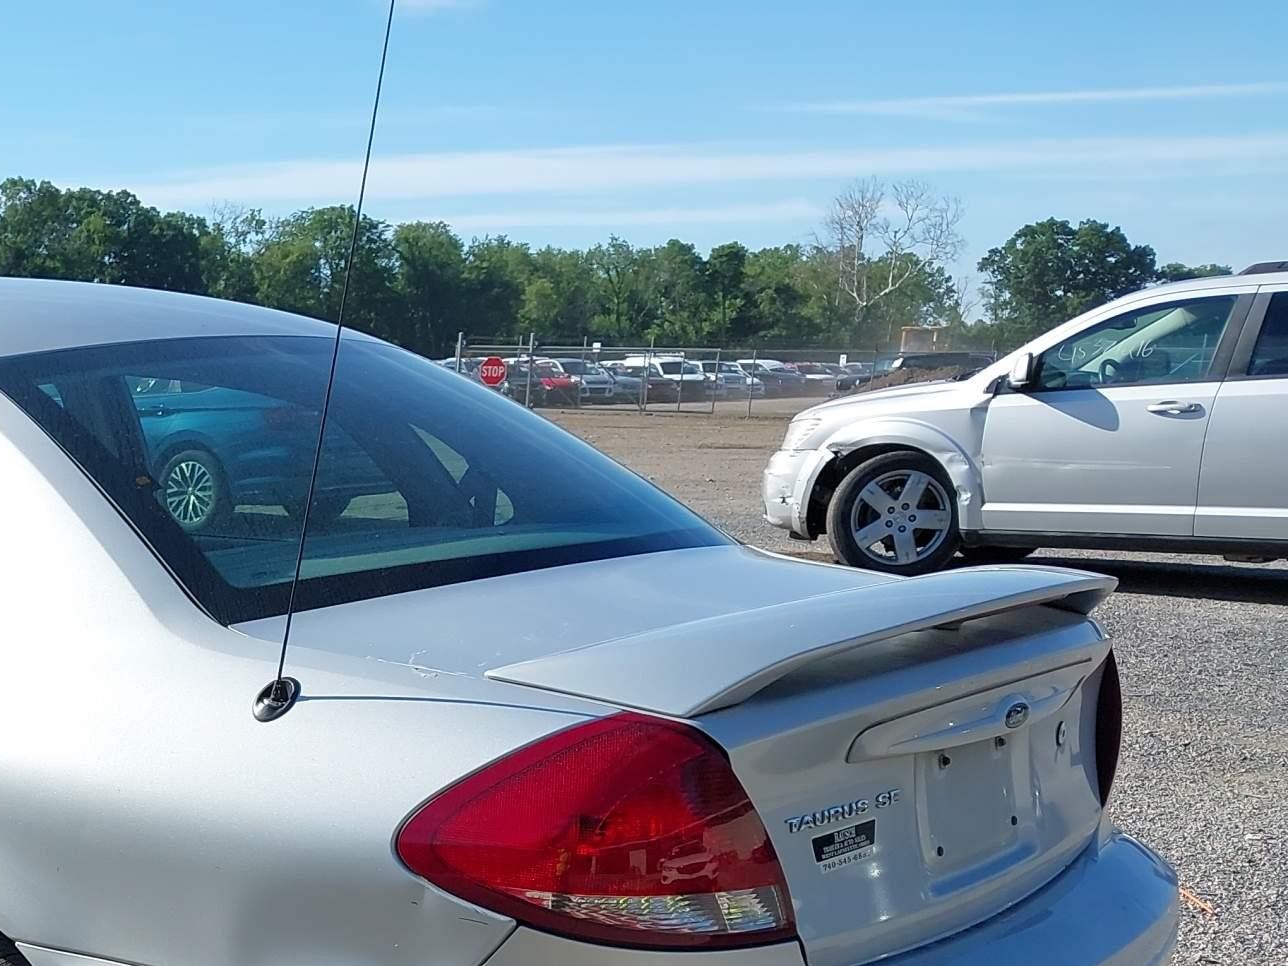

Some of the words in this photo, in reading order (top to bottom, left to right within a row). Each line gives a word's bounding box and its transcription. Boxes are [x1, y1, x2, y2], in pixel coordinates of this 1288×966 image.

[481, 365, 505, 377] STOP
[784, 799, 869, 833] TAURUS
[874, 788, 901, 808] SE
